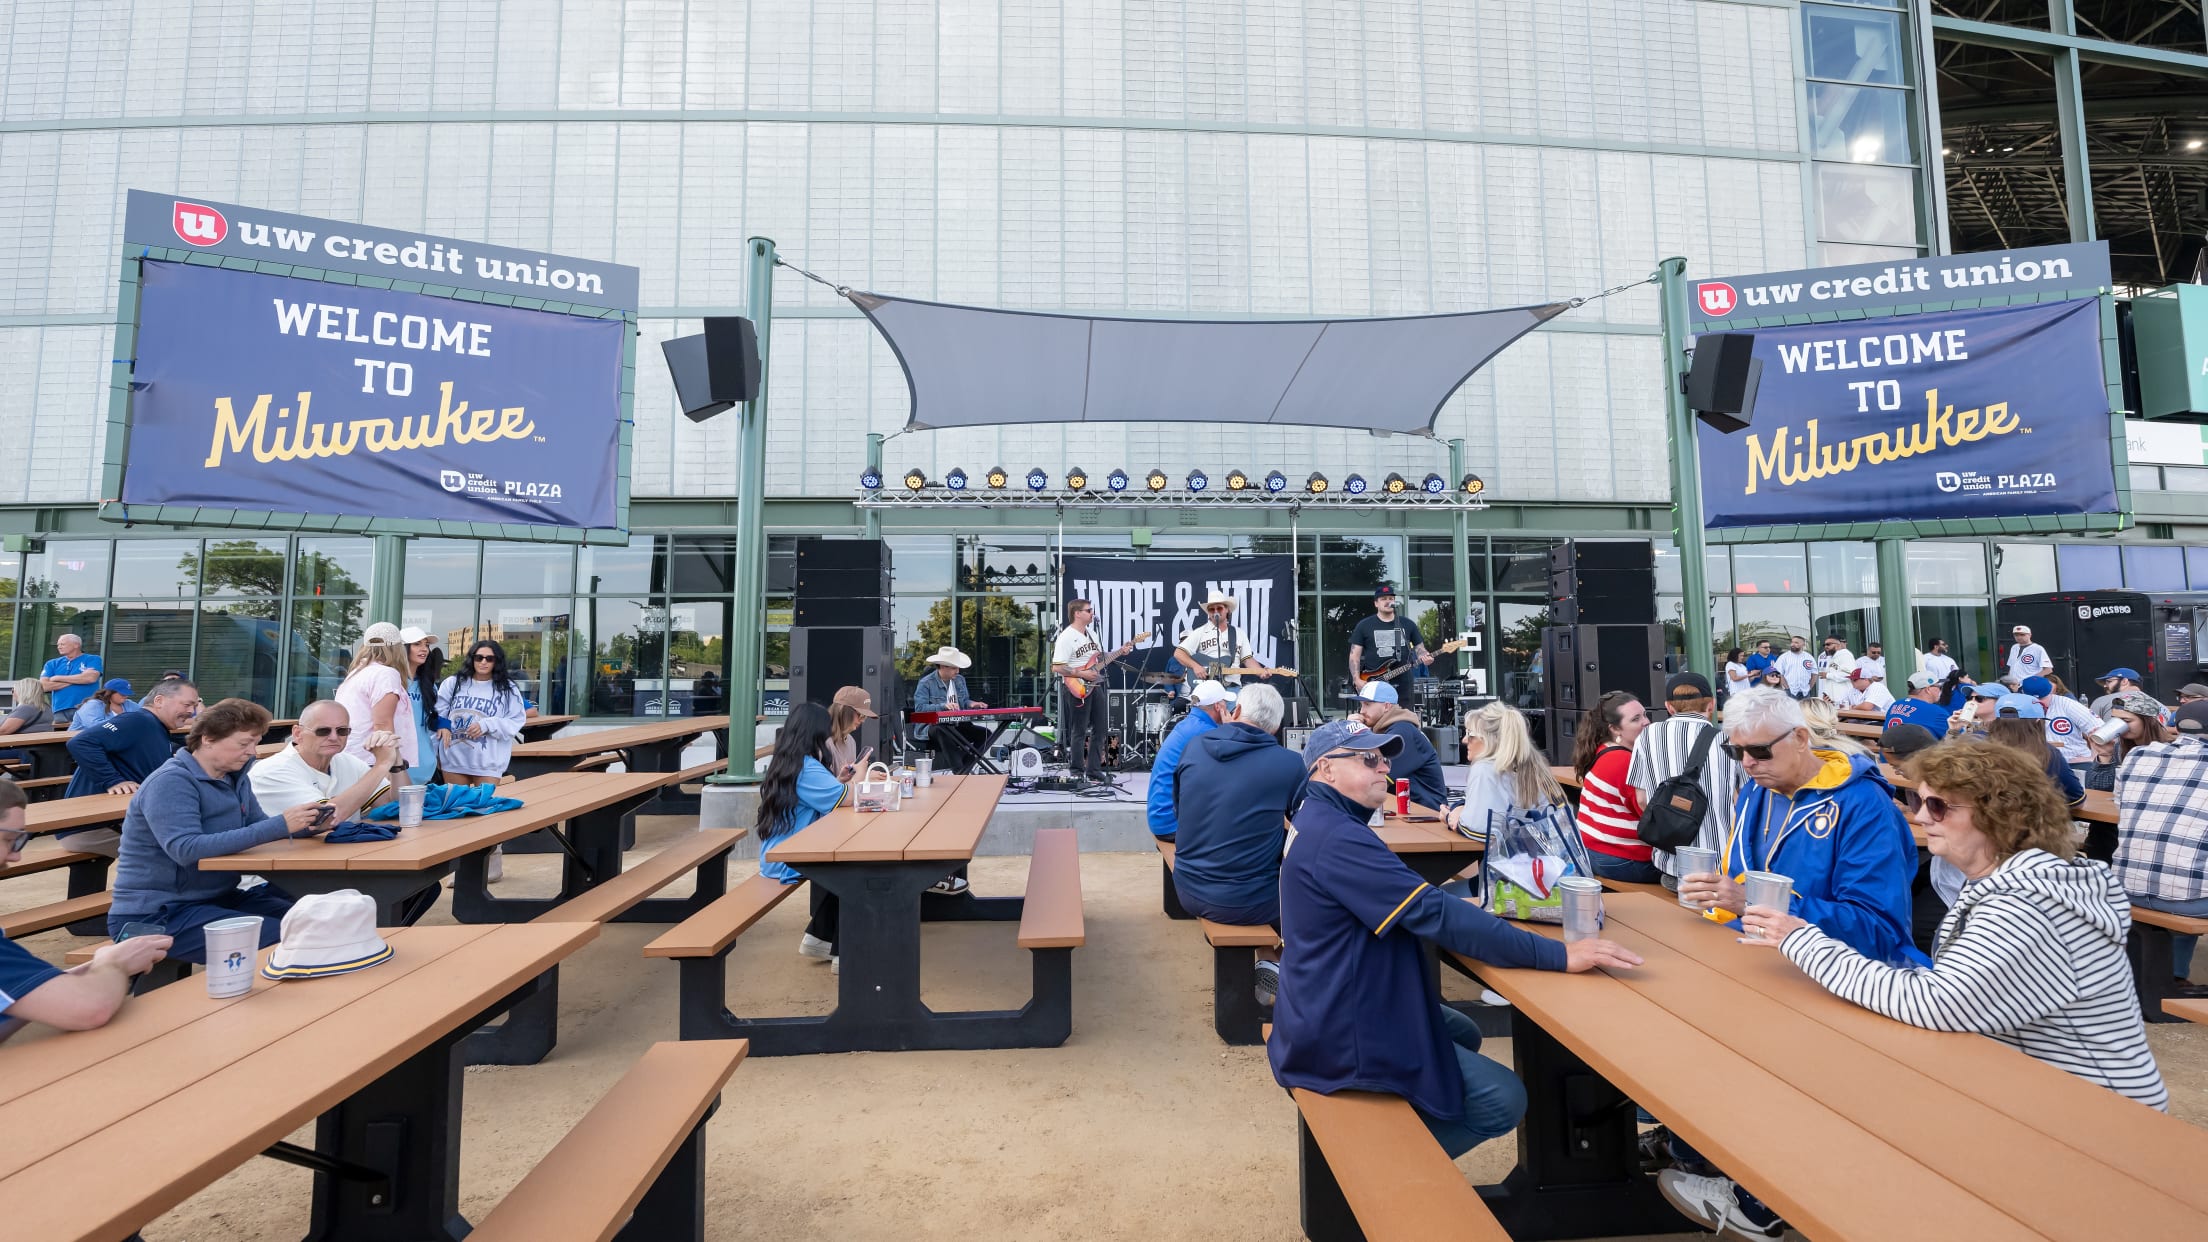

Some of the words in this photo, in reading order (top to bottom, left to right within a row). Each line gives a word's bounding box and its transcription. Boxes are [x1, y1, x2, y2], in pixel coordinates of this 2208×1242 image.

[237, 221, 316, 253] uw
[324, 235, 463, 275] credit
[475, 256, 604, 295] union
[1743, 283, 1803, 306] uw
[1809, 266, 1931, 300] credit
[1940, 256, 2073, 289] union
[273, 298, 492, 357] WELCOME
[1777, 329, 1968, 374] WELCOME
[354, 358, 413, 397] TO
[1848, 379, 1901, 413] TO
[204, 381, 535, 468] Milwaukee
[1744, 388, 2021, 496] Milwaukee
[2126, 436, 2147, 451] ank
[467, 479, 497, 487] credit
[467, 486, 498, 494] union
[504, 480, 562, 498] PLAZA
[1962, 476, 1991, 484] credit
[1997, 472, 2056, 489] PLAZA
[1172, 581, 1200, 648] &
[452, 695, 502, 718] EWERS
